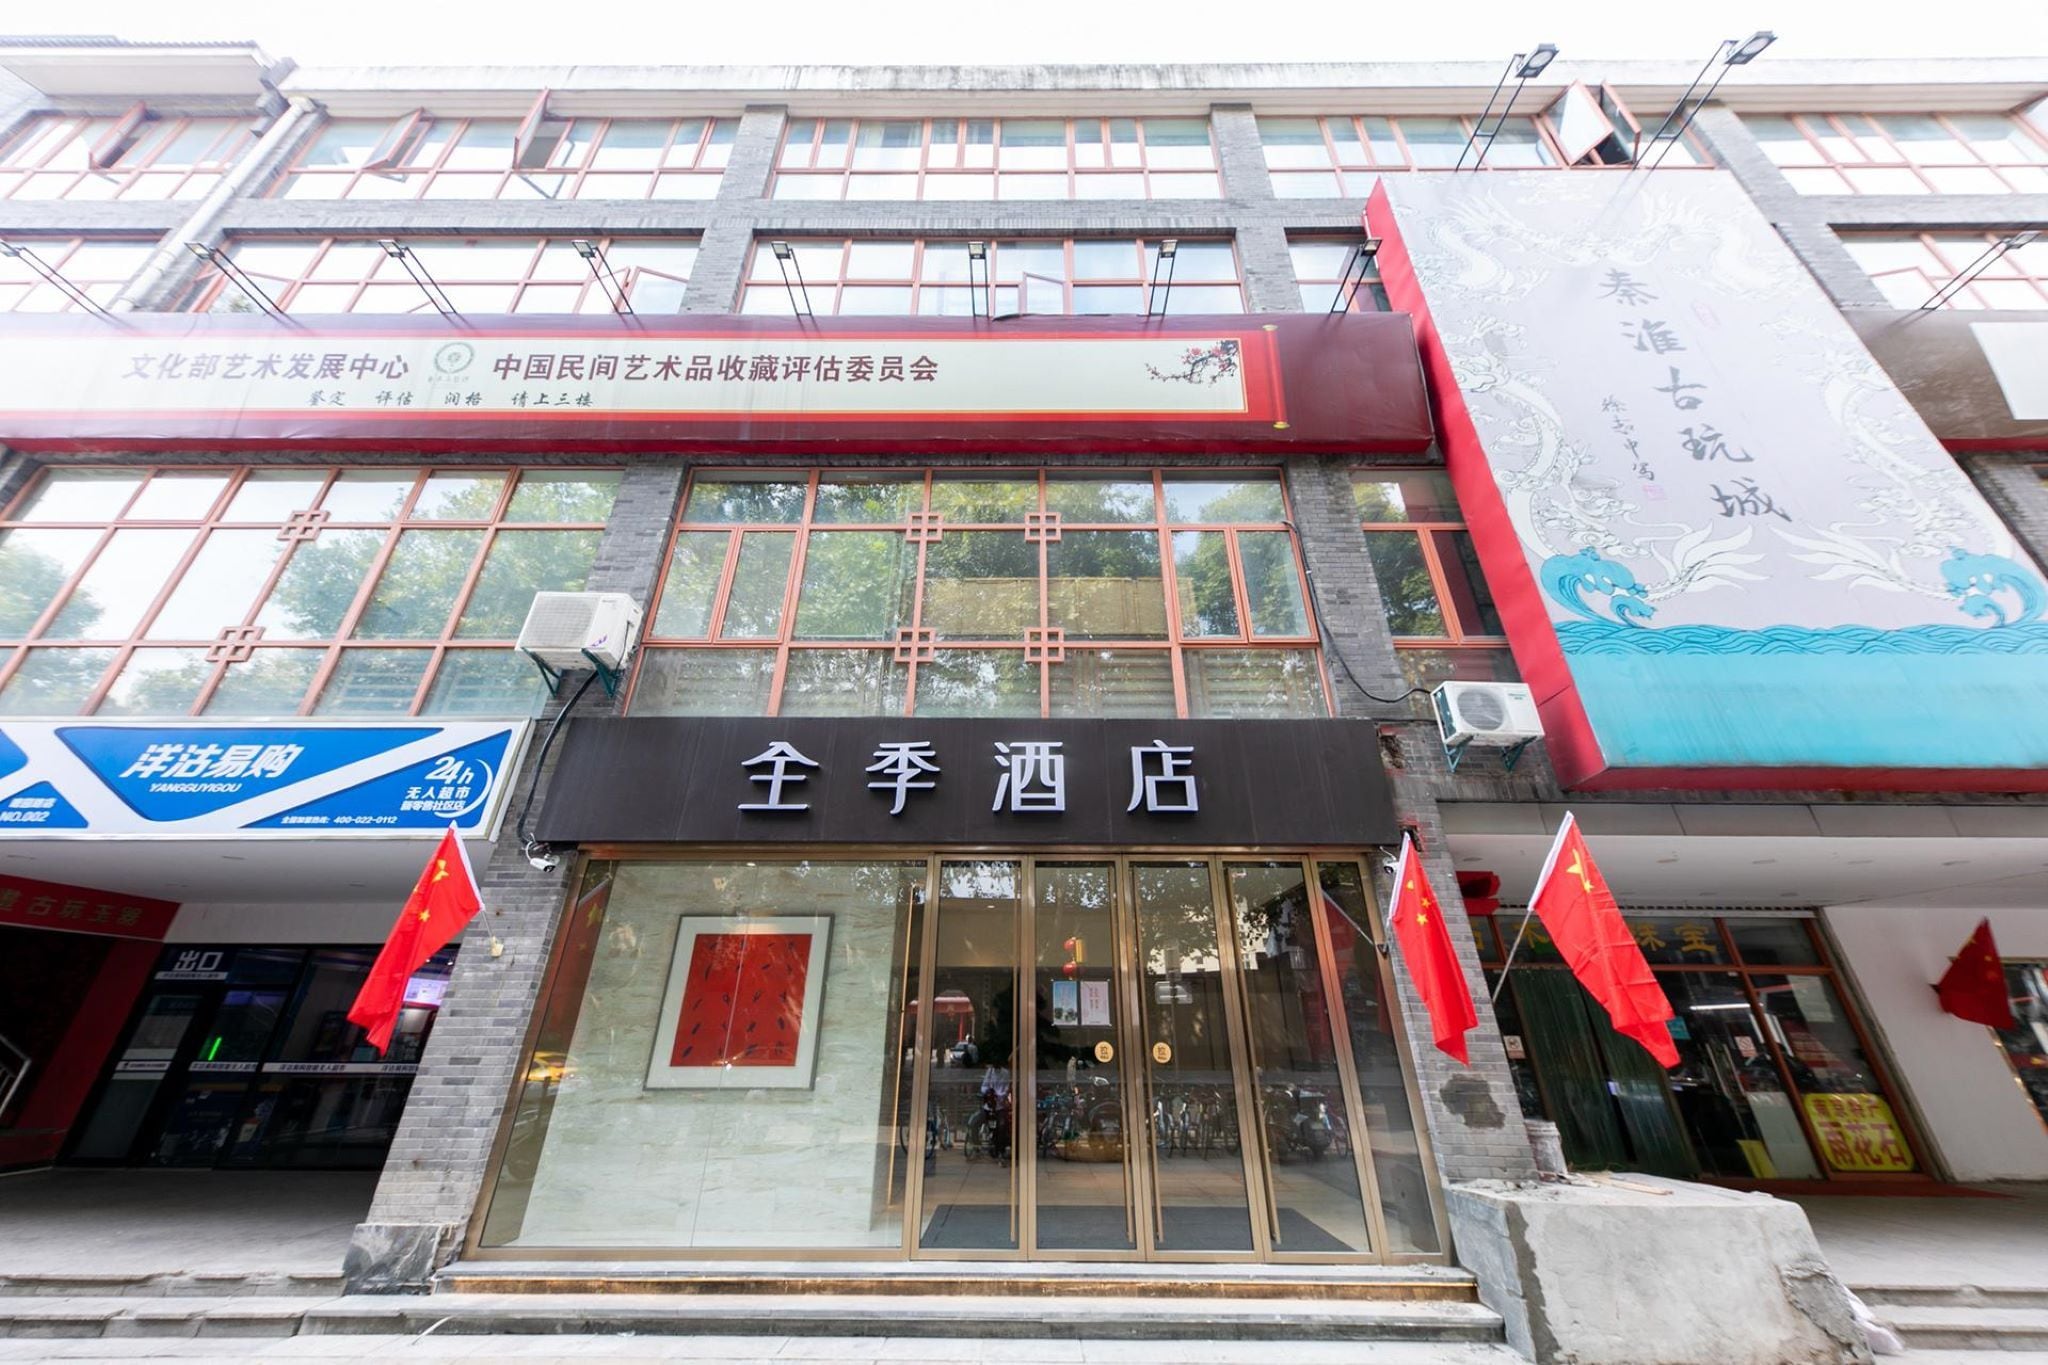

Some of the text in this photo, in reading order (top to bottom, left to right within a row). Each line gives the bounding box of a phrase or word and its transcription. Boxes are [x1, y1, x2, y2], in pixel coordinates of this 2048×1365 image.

[122, 352, 409, 380] 文化部艺术发展中心
[492, 353, 939, 382] 中国民间艺术品收藏评估委员会
[375, 390, 414, 406] 评估
[1600, 267, 1793, 523] 秦淮古玩城
[118, 743, 304, 778] 洋沽易购
[425, 756, 475, 785] 24h
[149, 782, 242, 793] YANGGUYIGOU
[737, 739, 1200, 815] 全季酒店
[405, 786, 471, 799] 无人超市
[172, 950, 224, 972] 出口
